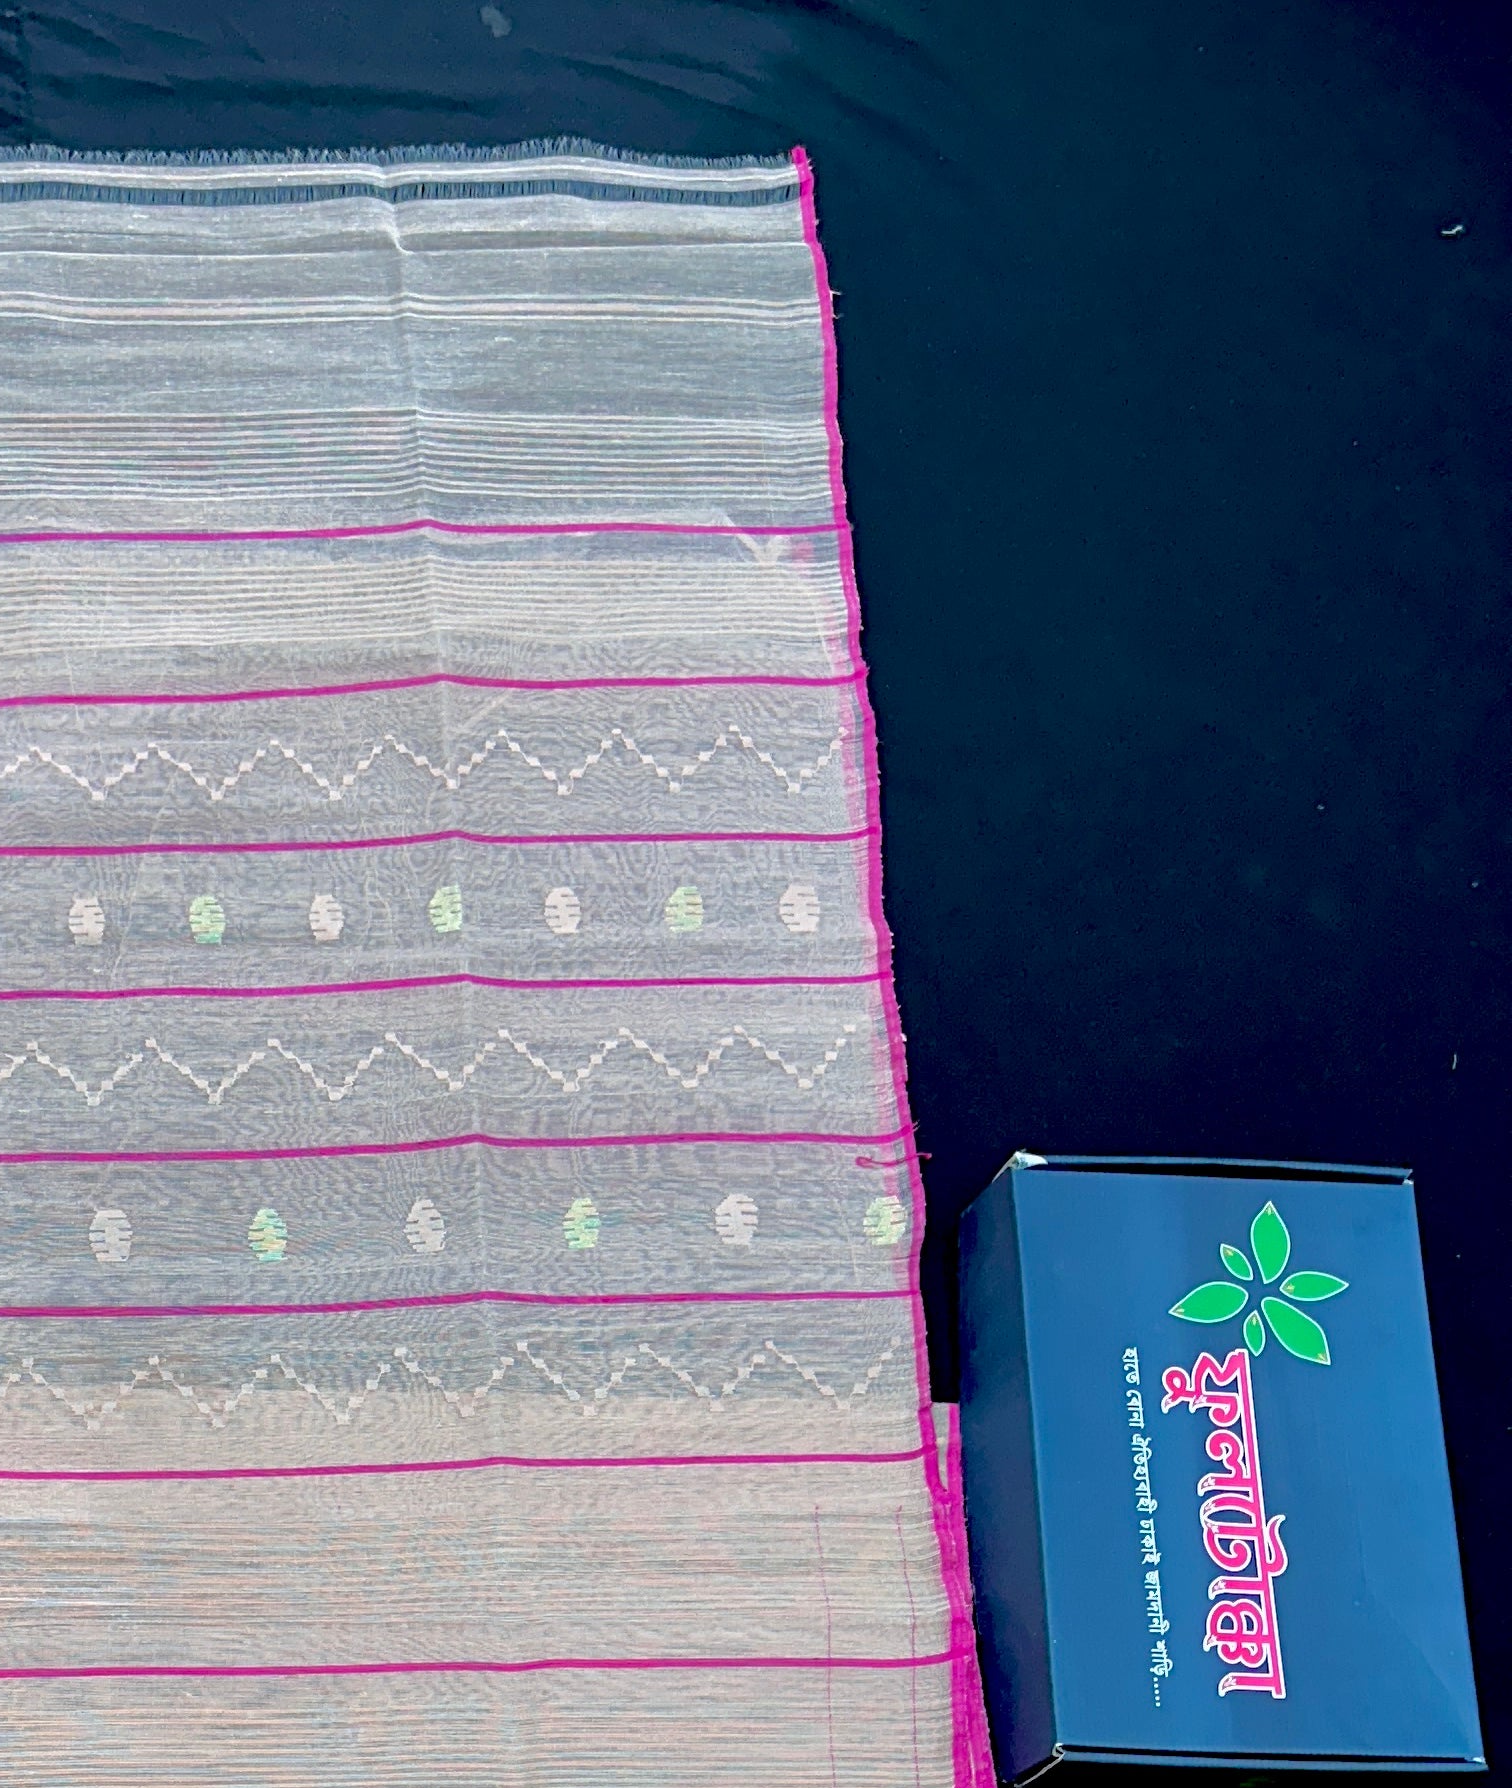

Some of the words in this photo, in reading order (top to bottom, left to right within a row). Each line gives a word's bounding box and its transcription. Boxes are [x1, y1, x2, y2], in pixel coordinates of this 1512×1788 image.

[1122, 1347, 1140, 1385] হাতে
[1126, 1390, 1144, 1428] বোনা
[1140, 1519, 1161, 1565] ঢাকাই
[1161, 1348, 1289, 1700] ফুলটোক্কা
[1145, 1570, 1169, 1635] জামদানী
